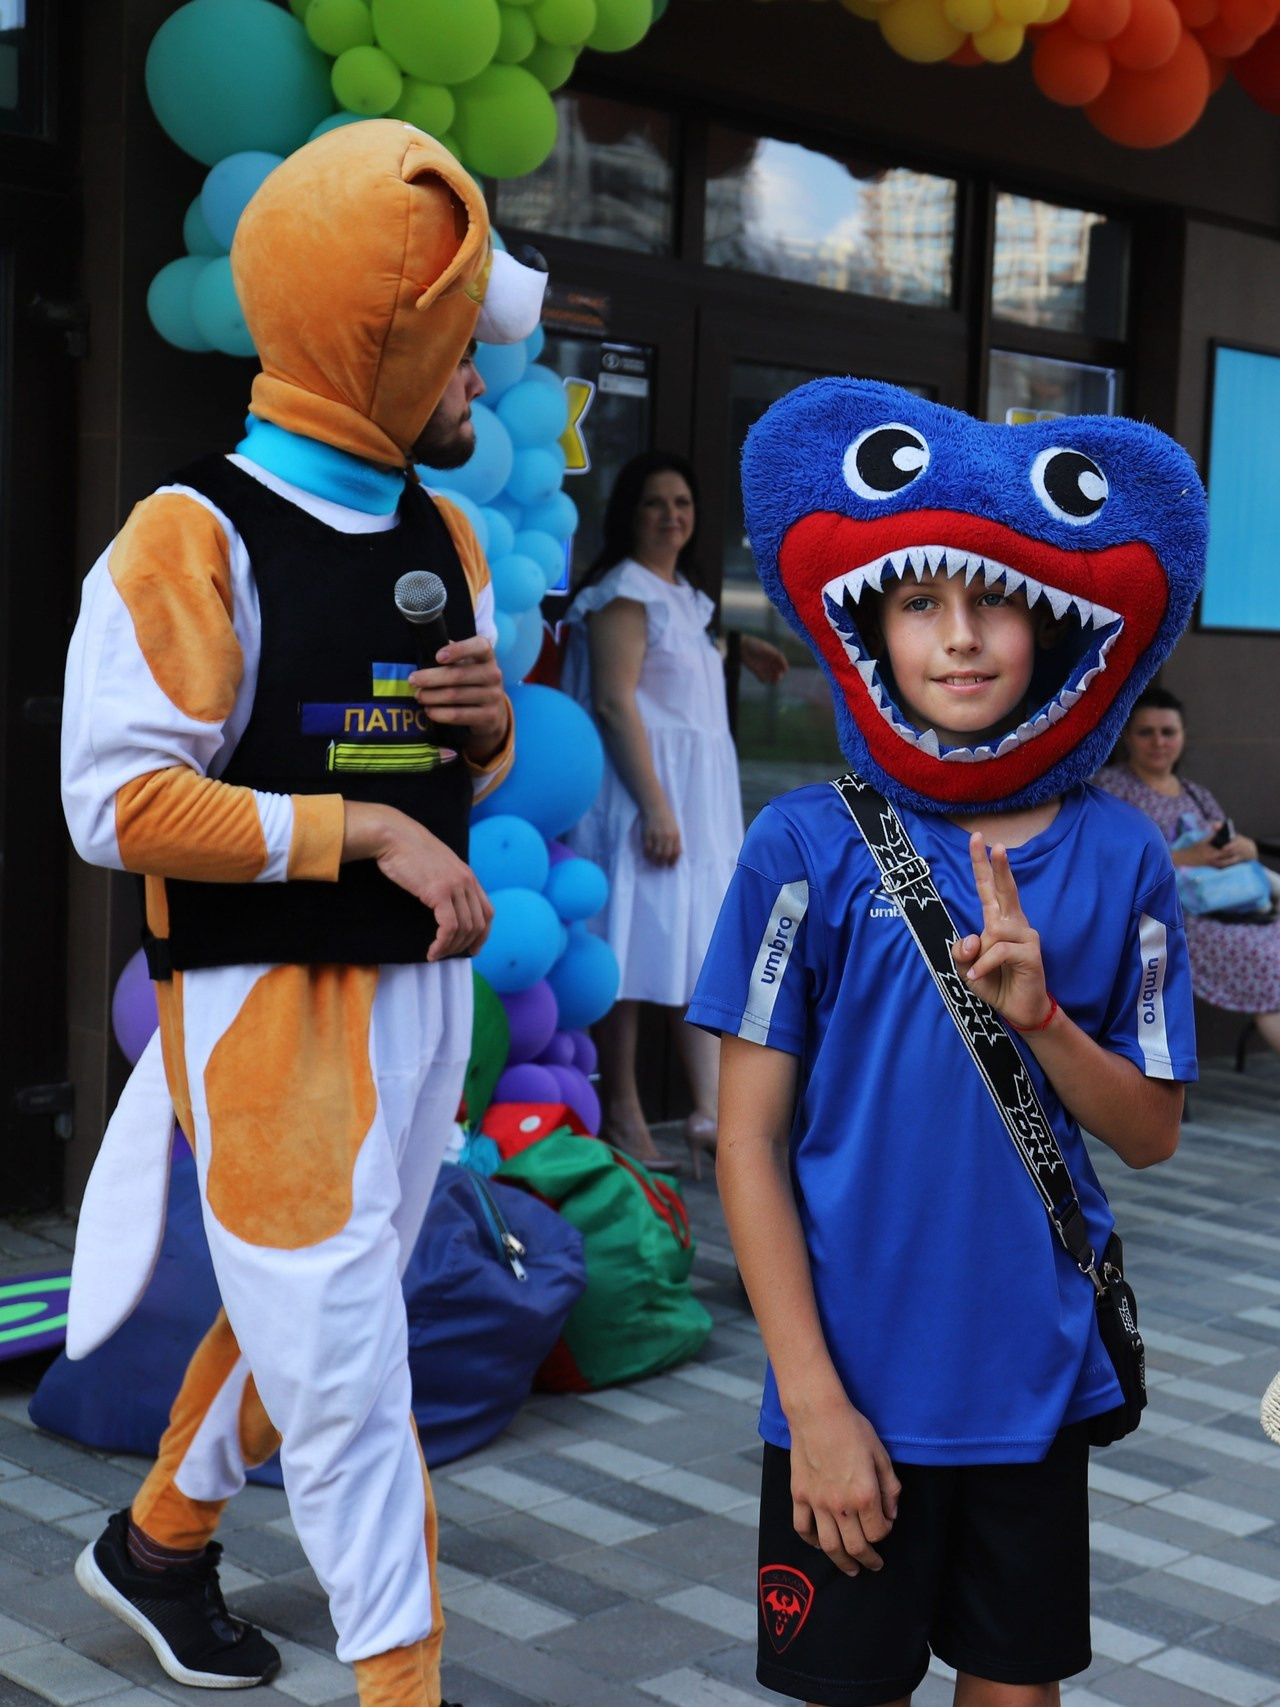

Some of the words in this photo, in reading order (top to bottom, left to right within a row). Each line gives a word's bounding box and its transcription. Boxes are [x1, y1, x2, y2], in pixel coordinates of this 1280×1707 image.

[344, 708, 431, 732] ПАТРО
[870, 907, 901, 918] umb
[761, 916, 793, 985] umbro
[1143, 957, 1160, 1025] umbro
